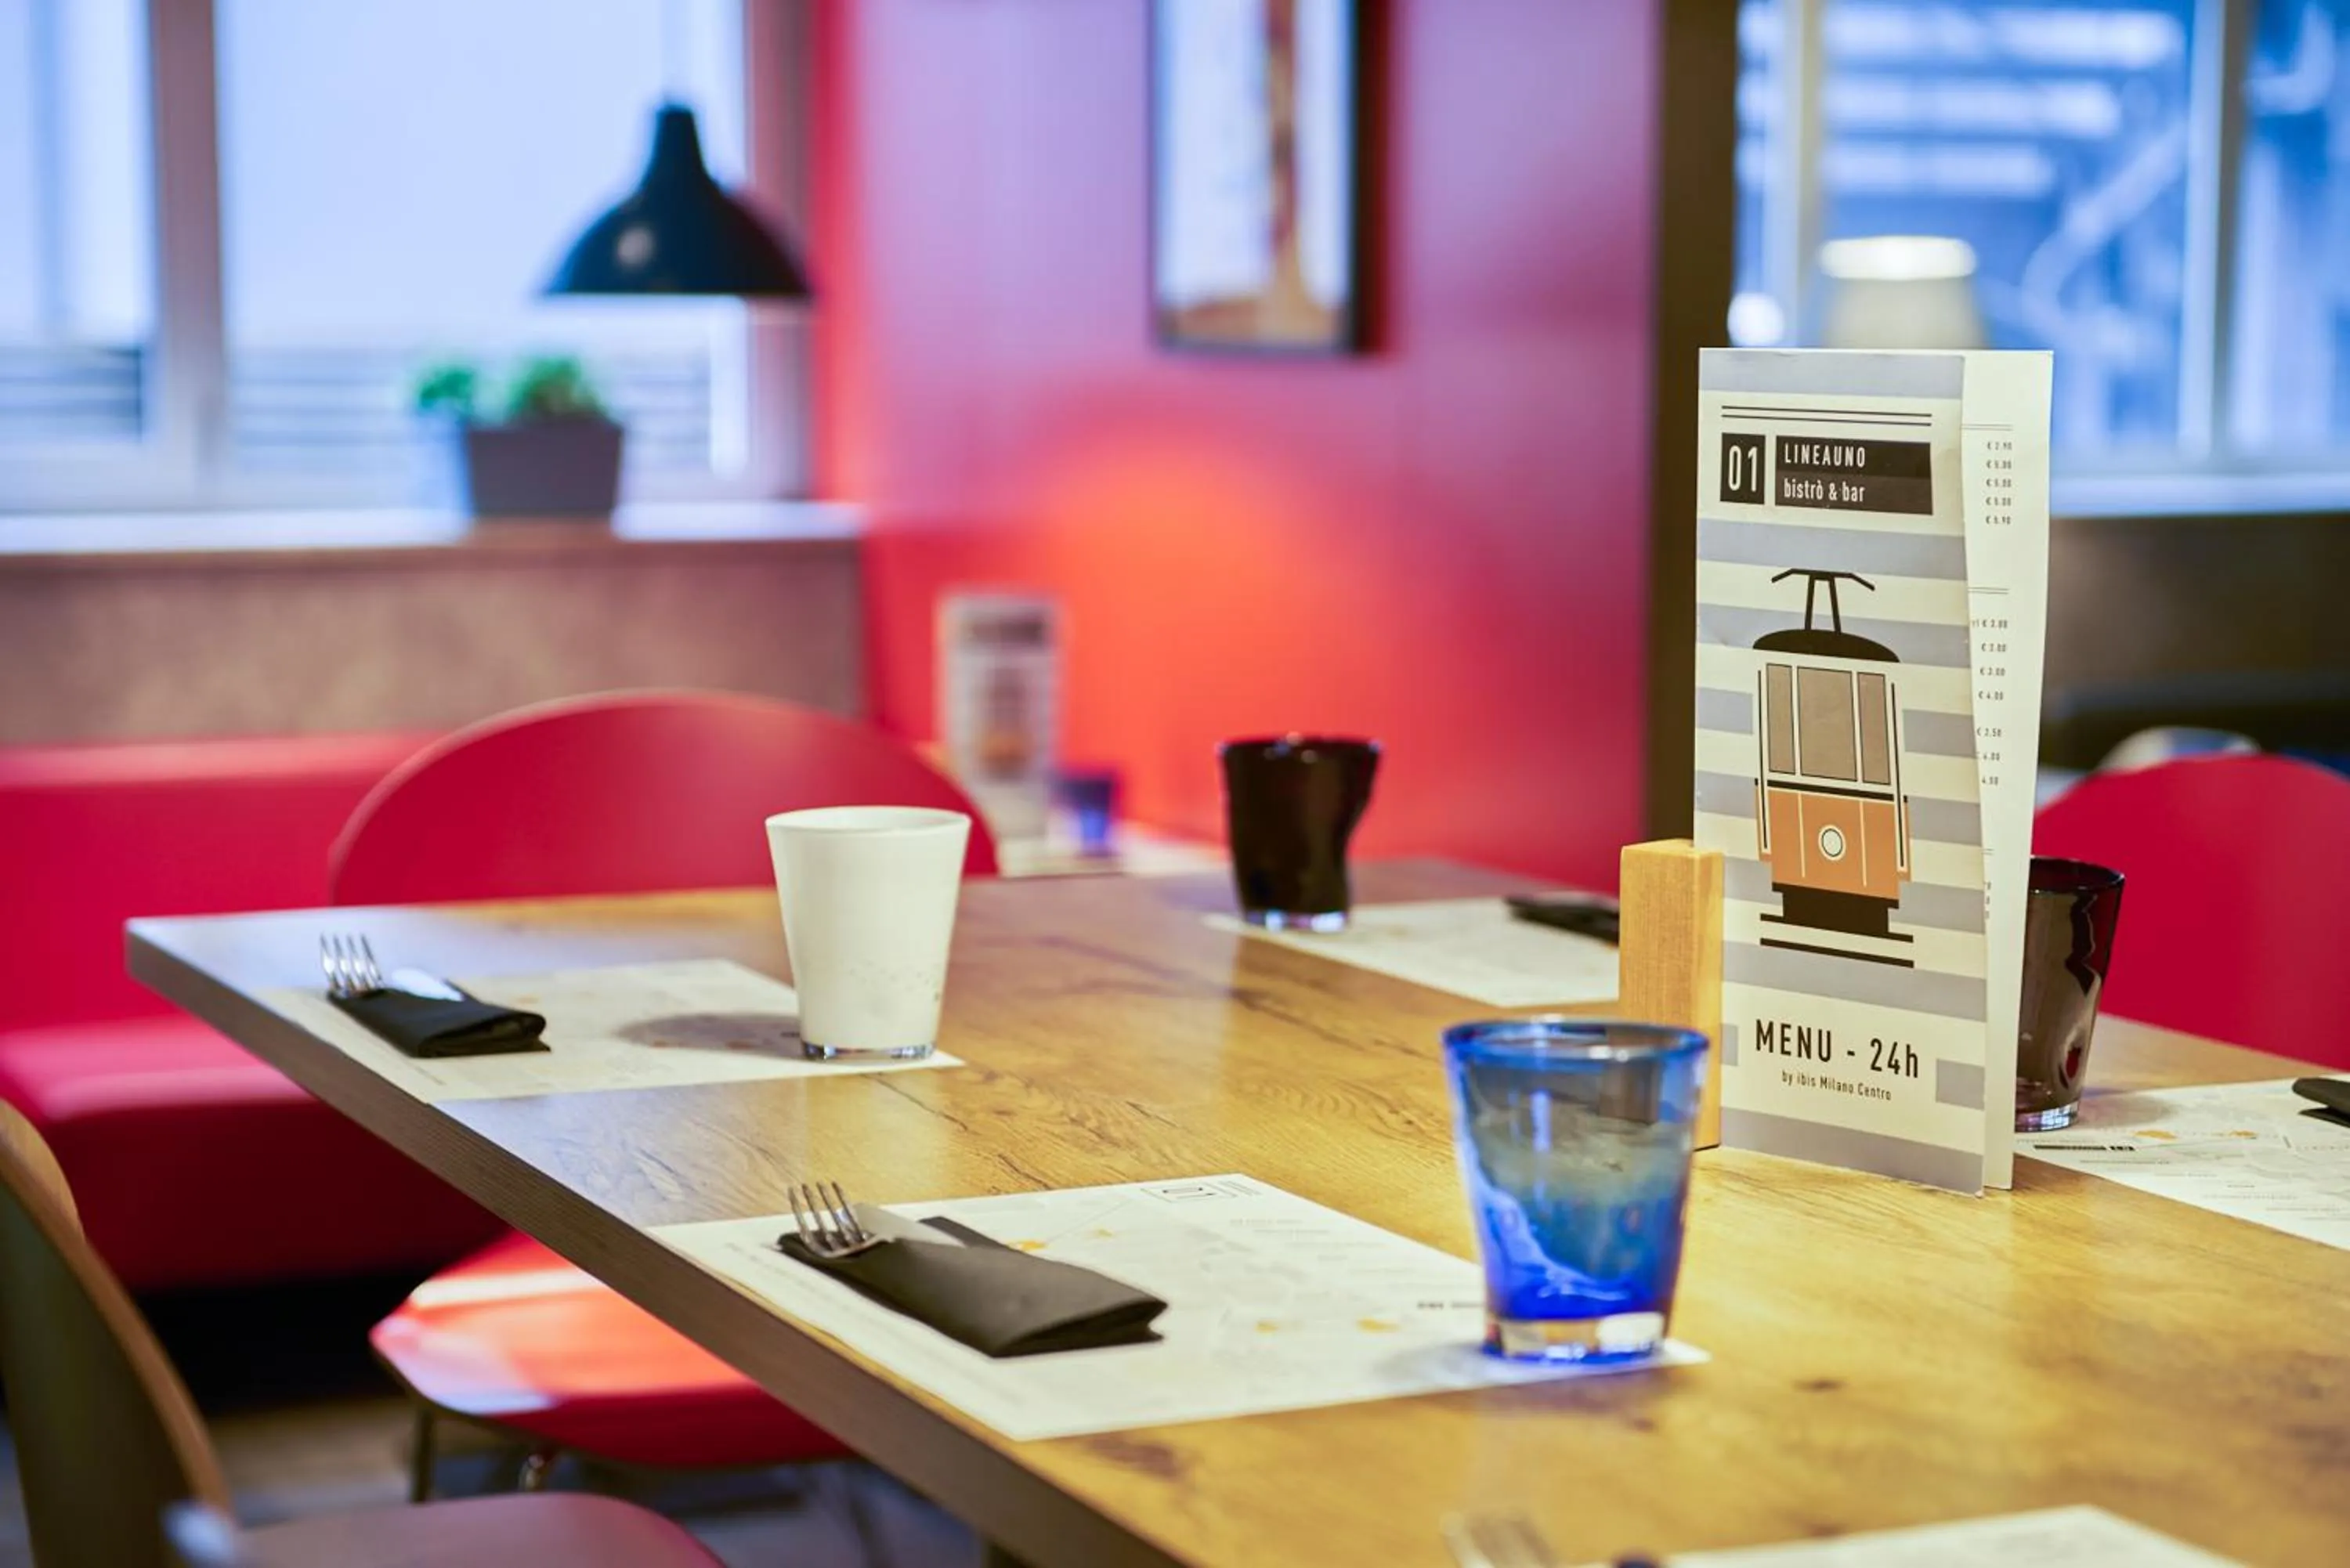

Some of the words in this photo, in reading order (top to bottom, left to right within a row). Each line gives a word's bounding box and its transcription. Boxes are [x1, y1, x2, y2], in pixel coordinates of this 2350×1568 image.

[1728, 444, 1758, 493] 01
[1784, 443, 1866, 468] LINEAUNO
[1783, 477, 1824, 500] bistrò
[1828, 482, 1838, 501] &
[1842, 480, 1866, 502] bar
[1755, 1018, 1831, 1063] MENU
[1846, 1049, 1856, 1057] -
[1870, 1037, 1918, 1078] 24h
[1781, 1070, 1793, 1086] by
[1796, 1072, 1817, 1087] ibis
[1820, 1076, 1854, 1094] Milano
[1857, 1082, 1892, 1100] Centro
